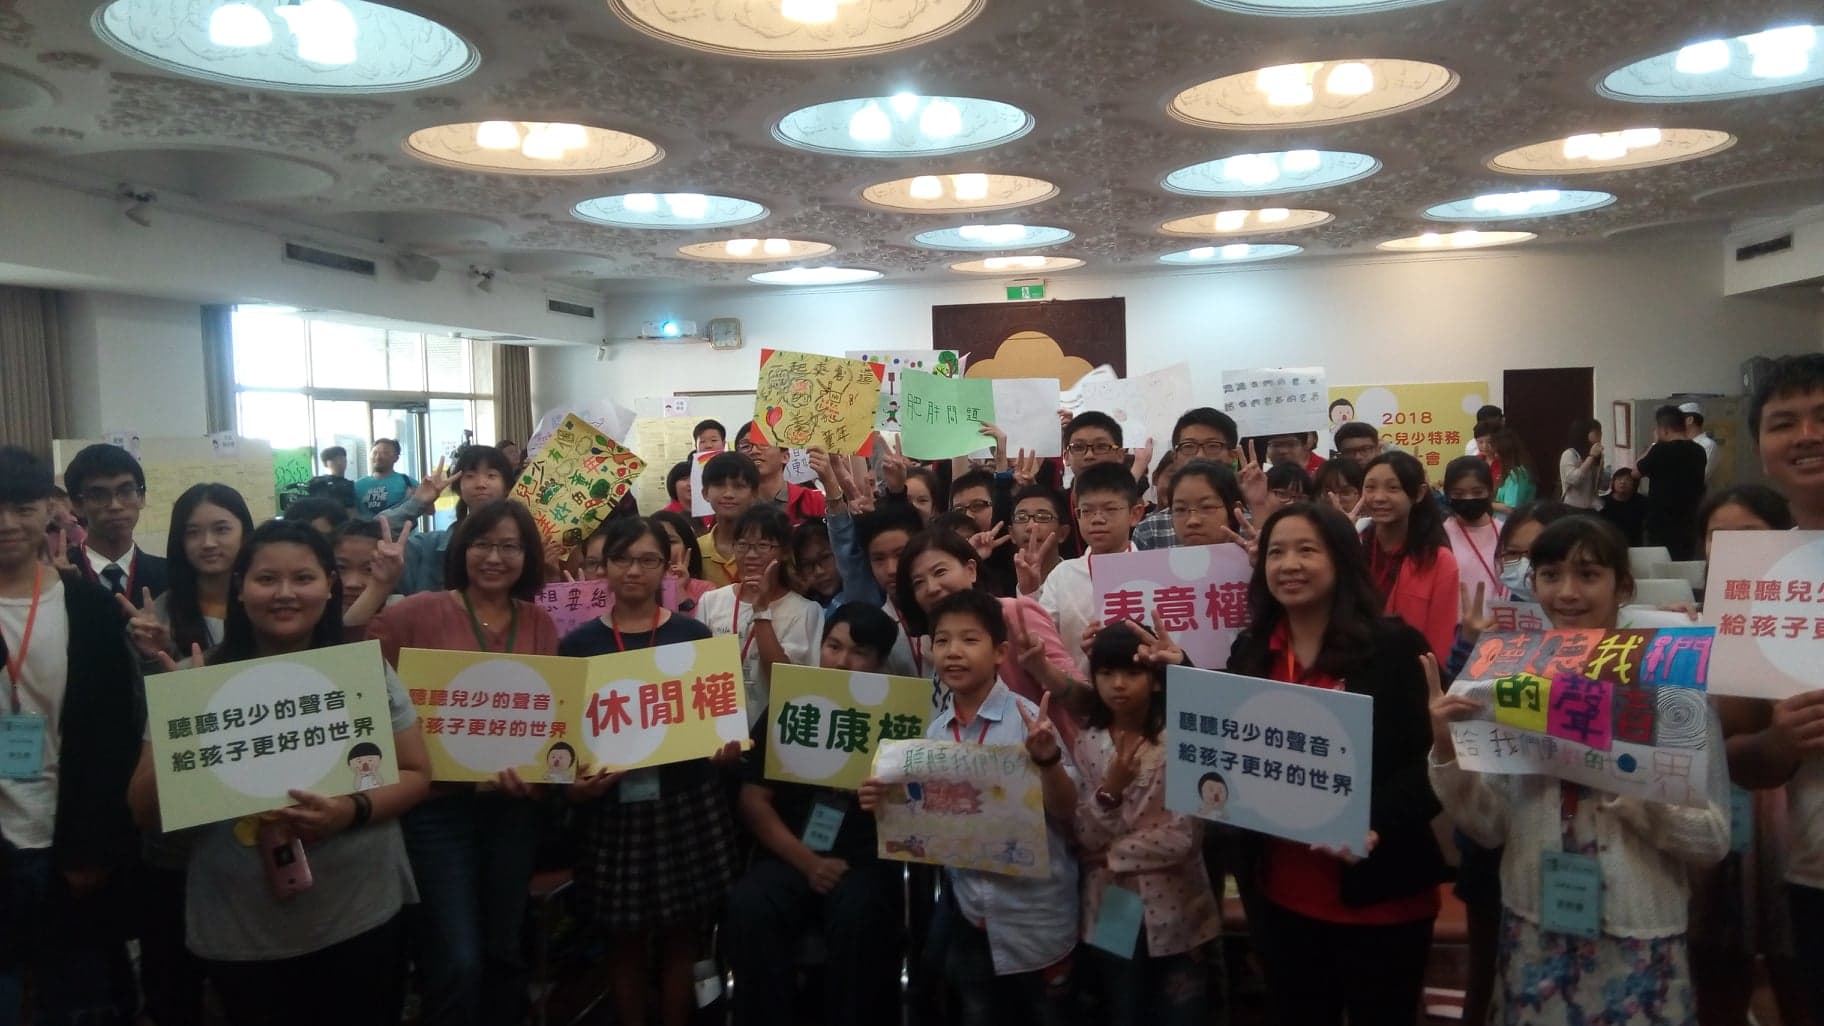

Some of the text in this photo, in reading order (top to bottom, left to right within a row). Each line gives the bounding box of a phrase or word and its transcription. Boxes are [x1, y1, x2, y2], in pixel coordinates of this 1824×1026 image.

[907, 393, 981, 425] 肥胖問題
[1382, 411, 1432, 425] 2018
[1103, 582, 1250, 632] 表意權
[167, 690, 363, 740] 聽聽兒少的聲音，
[416, 716, 567, 738] 孩子更好的世界
[585, 671, 738, 738] 休閒權
[777, 701, 923, 754] 健康權
[171, 716, 376, 773] 給孩子更好的世界
[1179, 711, 1347, 758] 聽聽兒少的聲音，
[1178, 742, 1353, 797] 給孩子更好的世界
